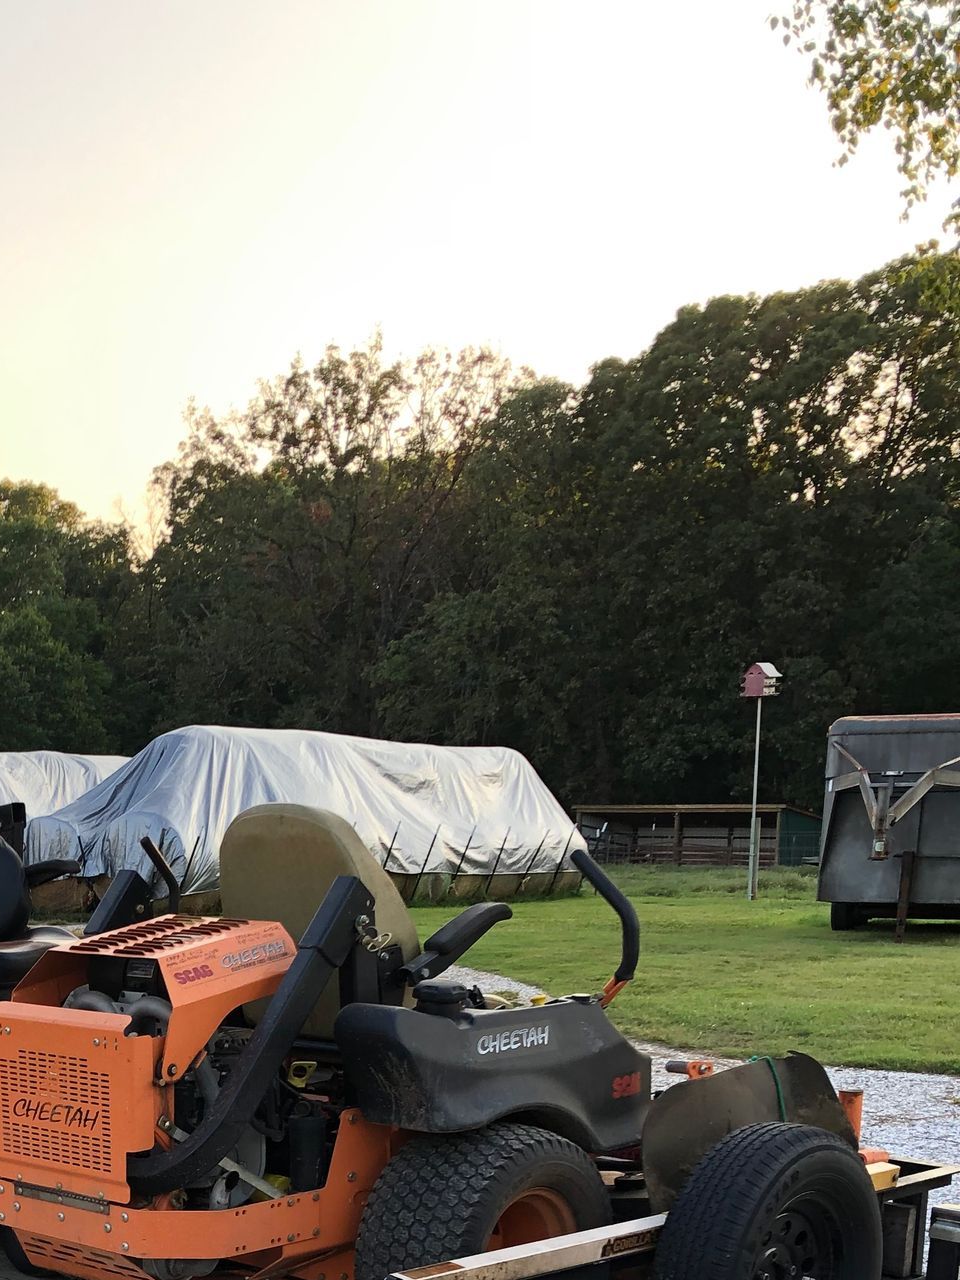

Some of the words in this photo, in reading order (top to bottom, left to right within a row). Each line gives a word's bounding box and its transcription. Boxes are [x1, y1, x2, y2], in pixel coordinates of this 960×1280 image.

[222, 940, 286, 968] CHEETAH
[174, 965, 213, 984] SCAG
[477, 1025, 550, 1055] CHEETAH
[13, 1098, 100, 1131] CHEETAH
